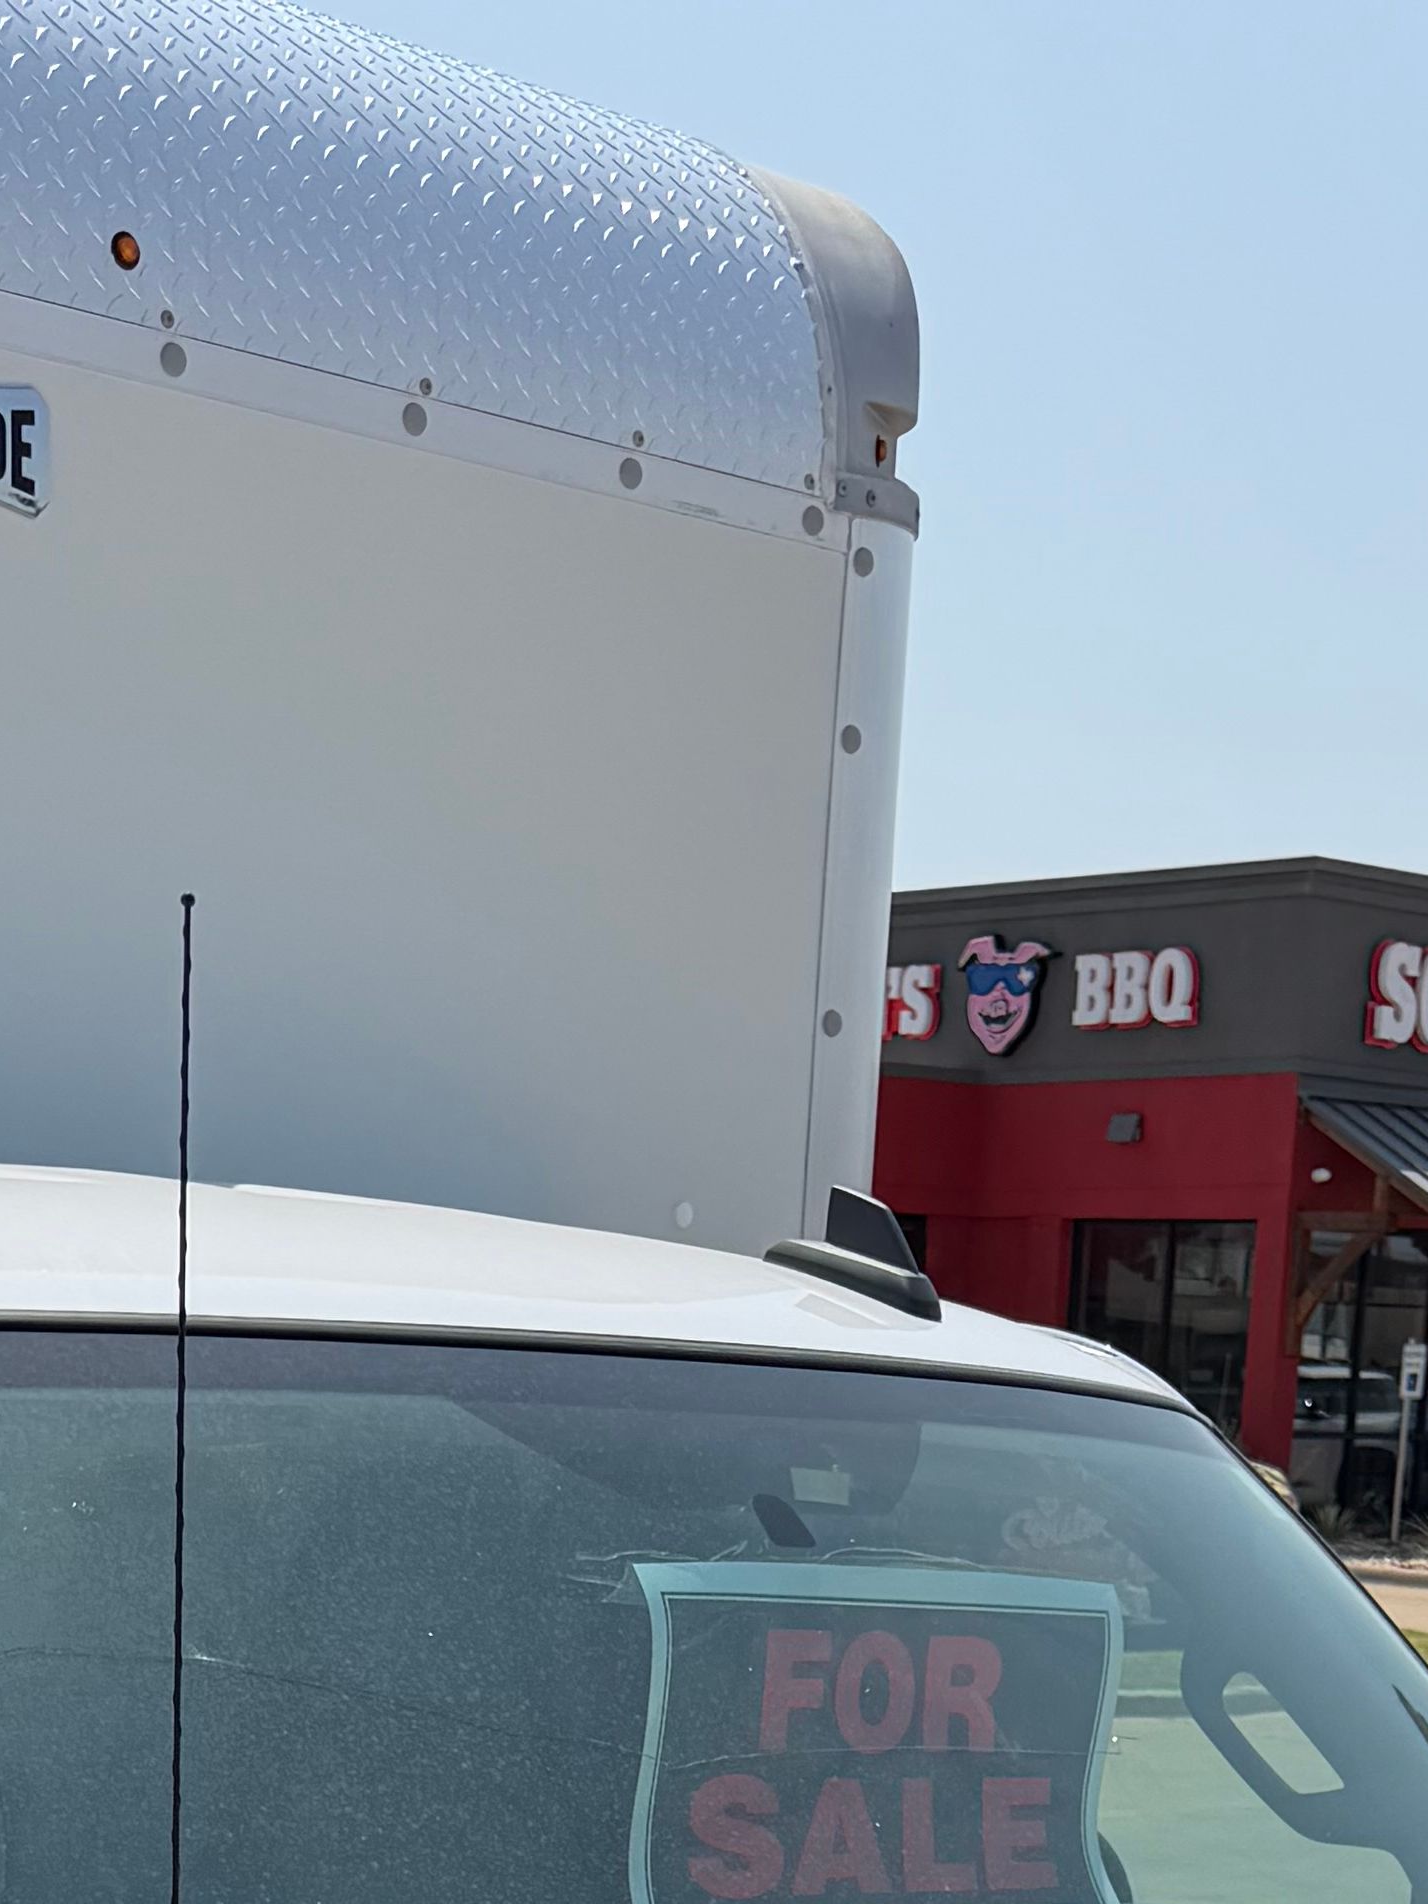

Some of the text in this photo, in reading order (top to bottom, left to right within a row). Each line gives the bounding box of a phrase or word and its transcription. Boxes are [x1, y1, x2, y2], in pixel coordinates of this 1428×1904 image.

[1071, 947, 1196, 1028] BBQ
[756, 1629, 1005, 1757] FOR
[687, 1773, 1061, 1901] SALE
